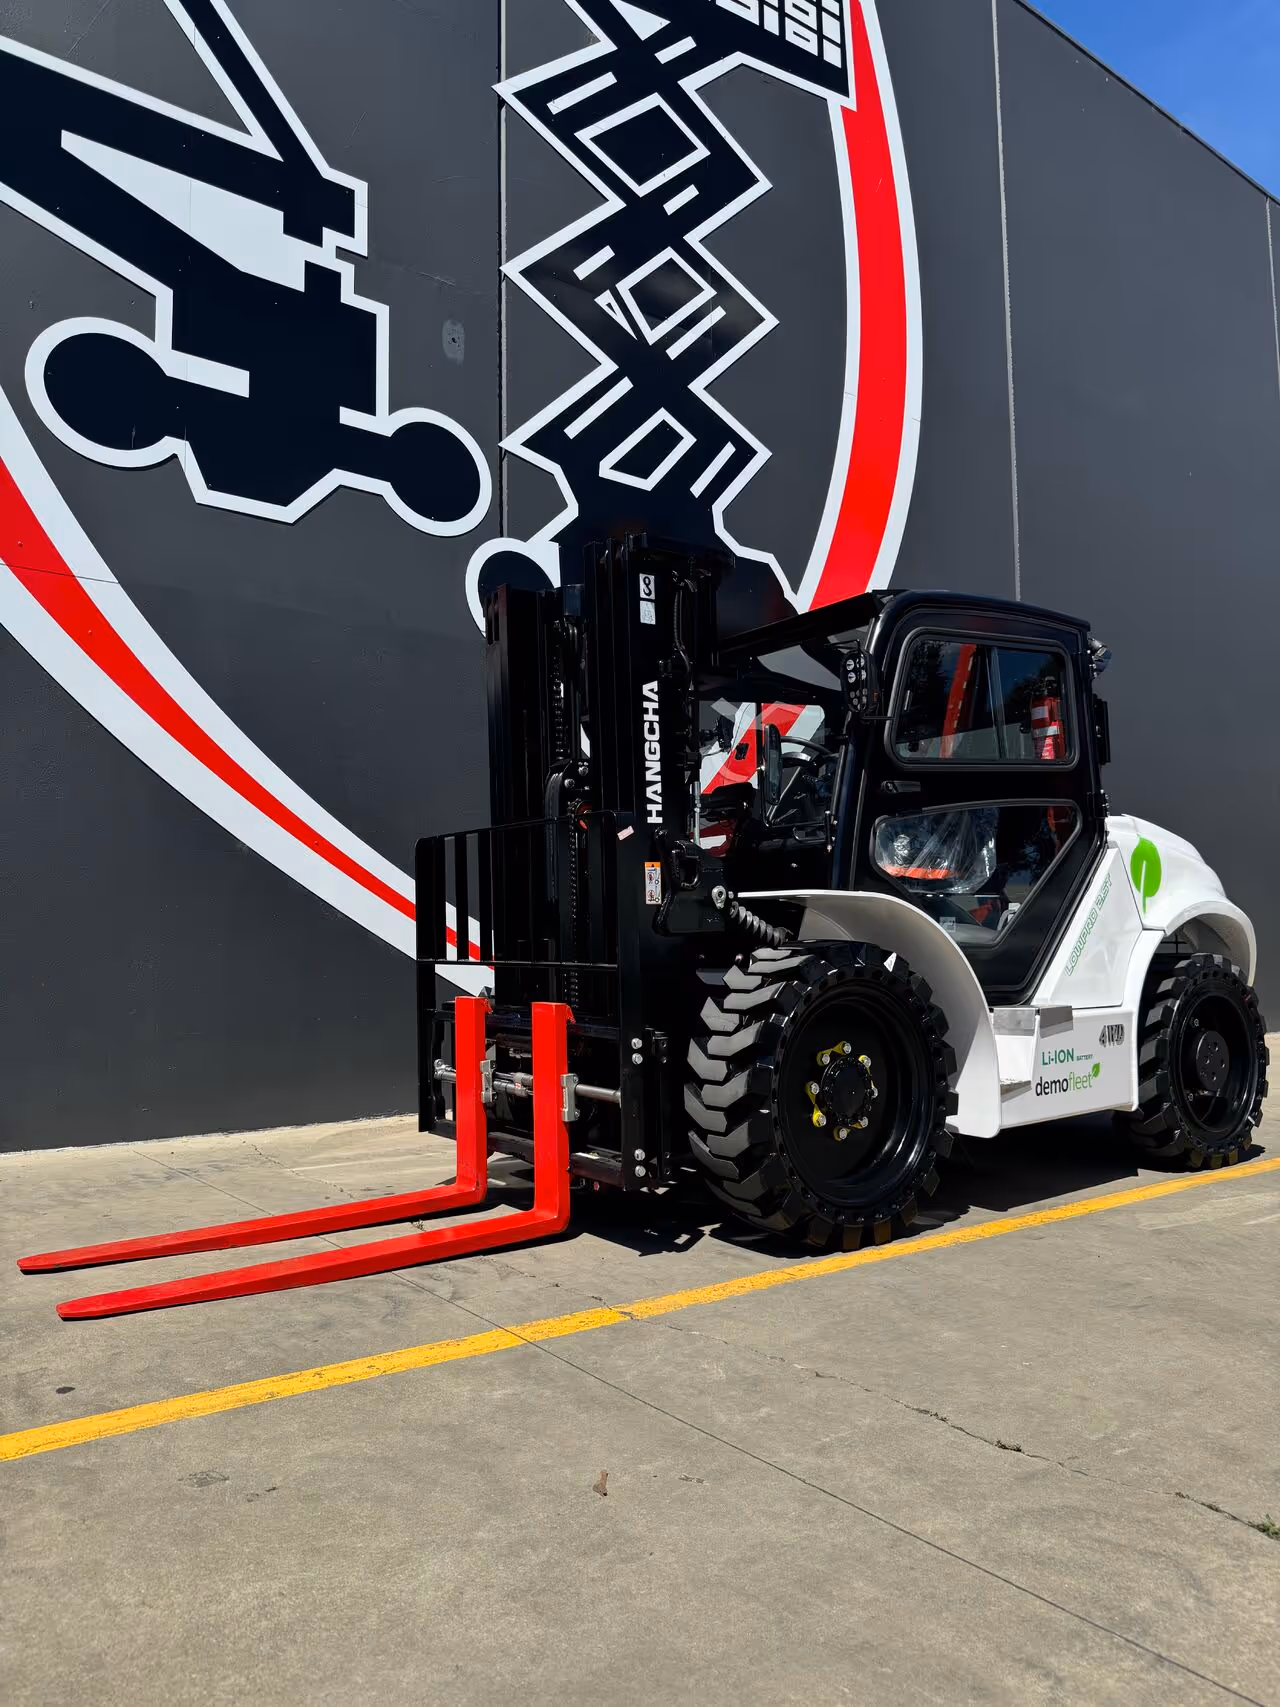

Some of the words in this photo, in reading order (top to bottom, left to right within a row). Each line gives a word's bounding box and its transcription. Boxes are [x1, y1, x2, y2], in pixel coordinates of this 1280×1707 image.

[642, 680, 663, 824] HANGCHA
[1065, 907, 1098, 977] LOWPRO
[1099, 1023, 1125, 1048] 4WD
[1035, 1071, 1093, 1097] demofleet
